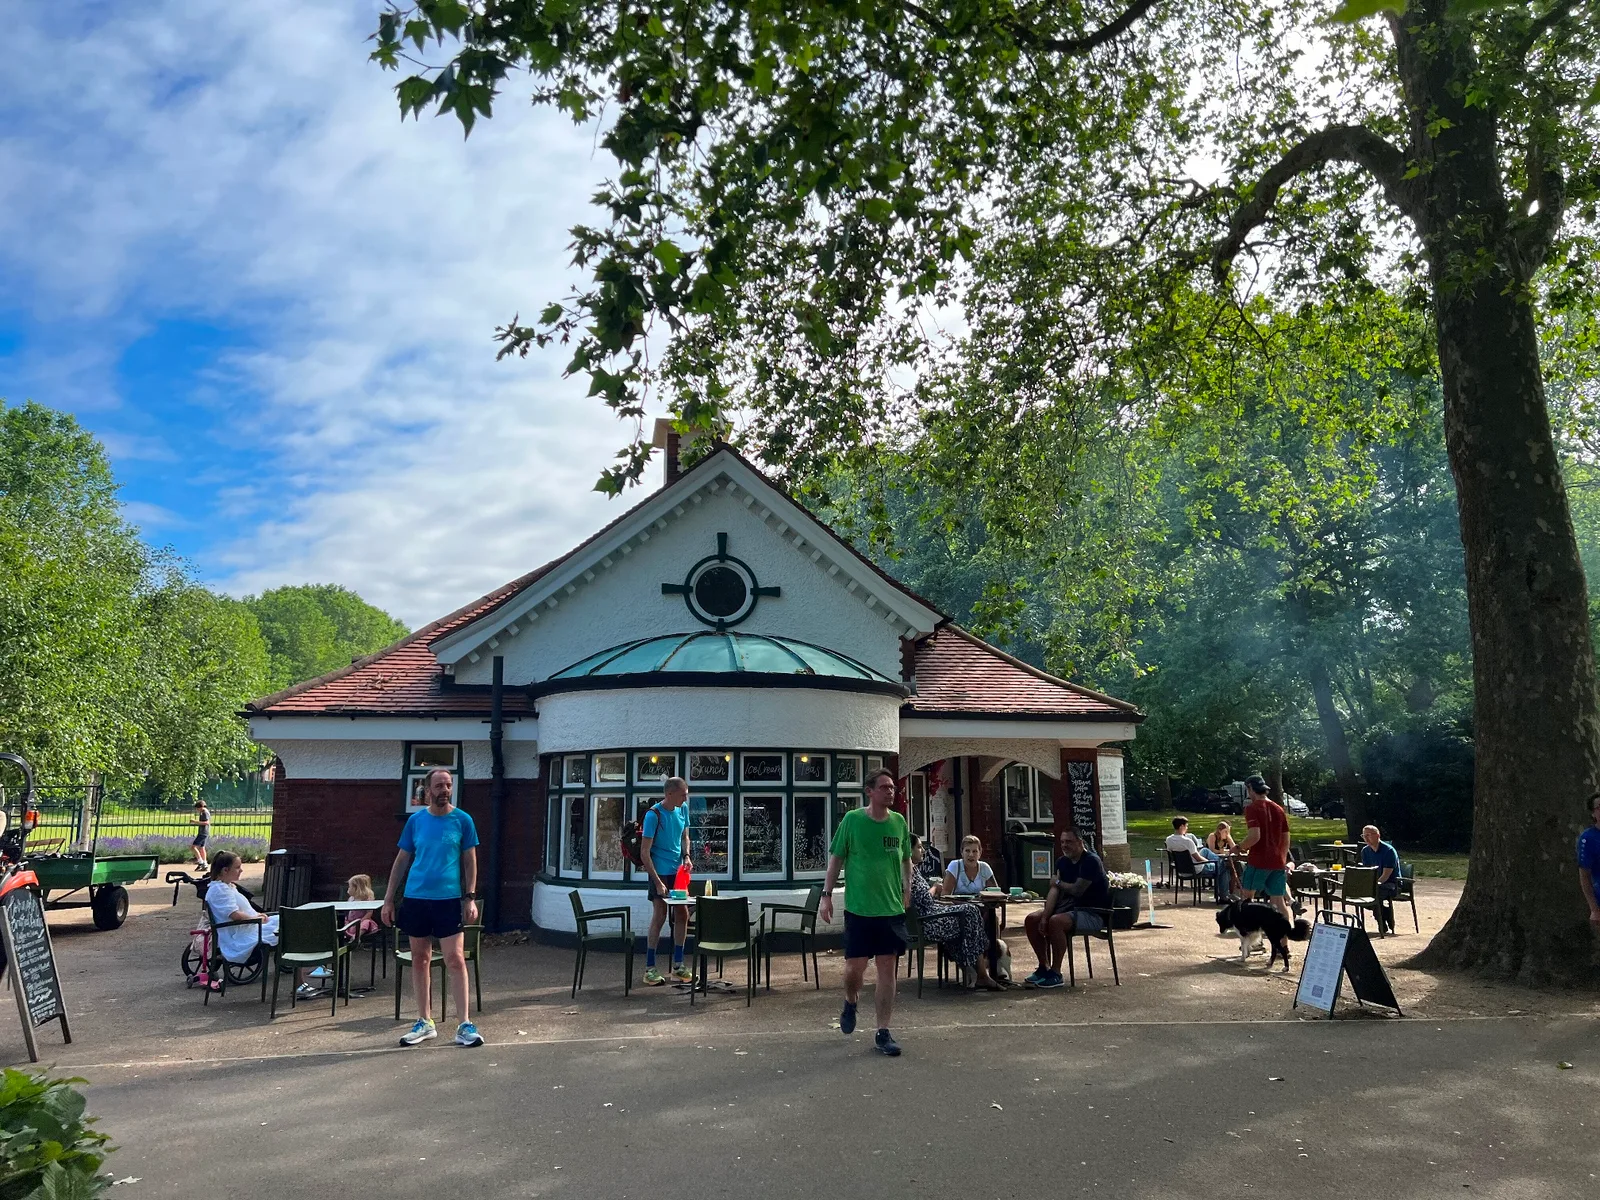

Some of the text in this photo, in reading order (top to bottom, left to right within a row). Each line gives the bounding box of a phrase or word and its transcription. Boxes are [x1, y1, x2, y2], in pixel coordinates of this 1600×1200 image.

[691, 756, 727, 779] Brunch
[712, 827, 726, 838] Tea
[883, 836, 899, 848] FOUR
